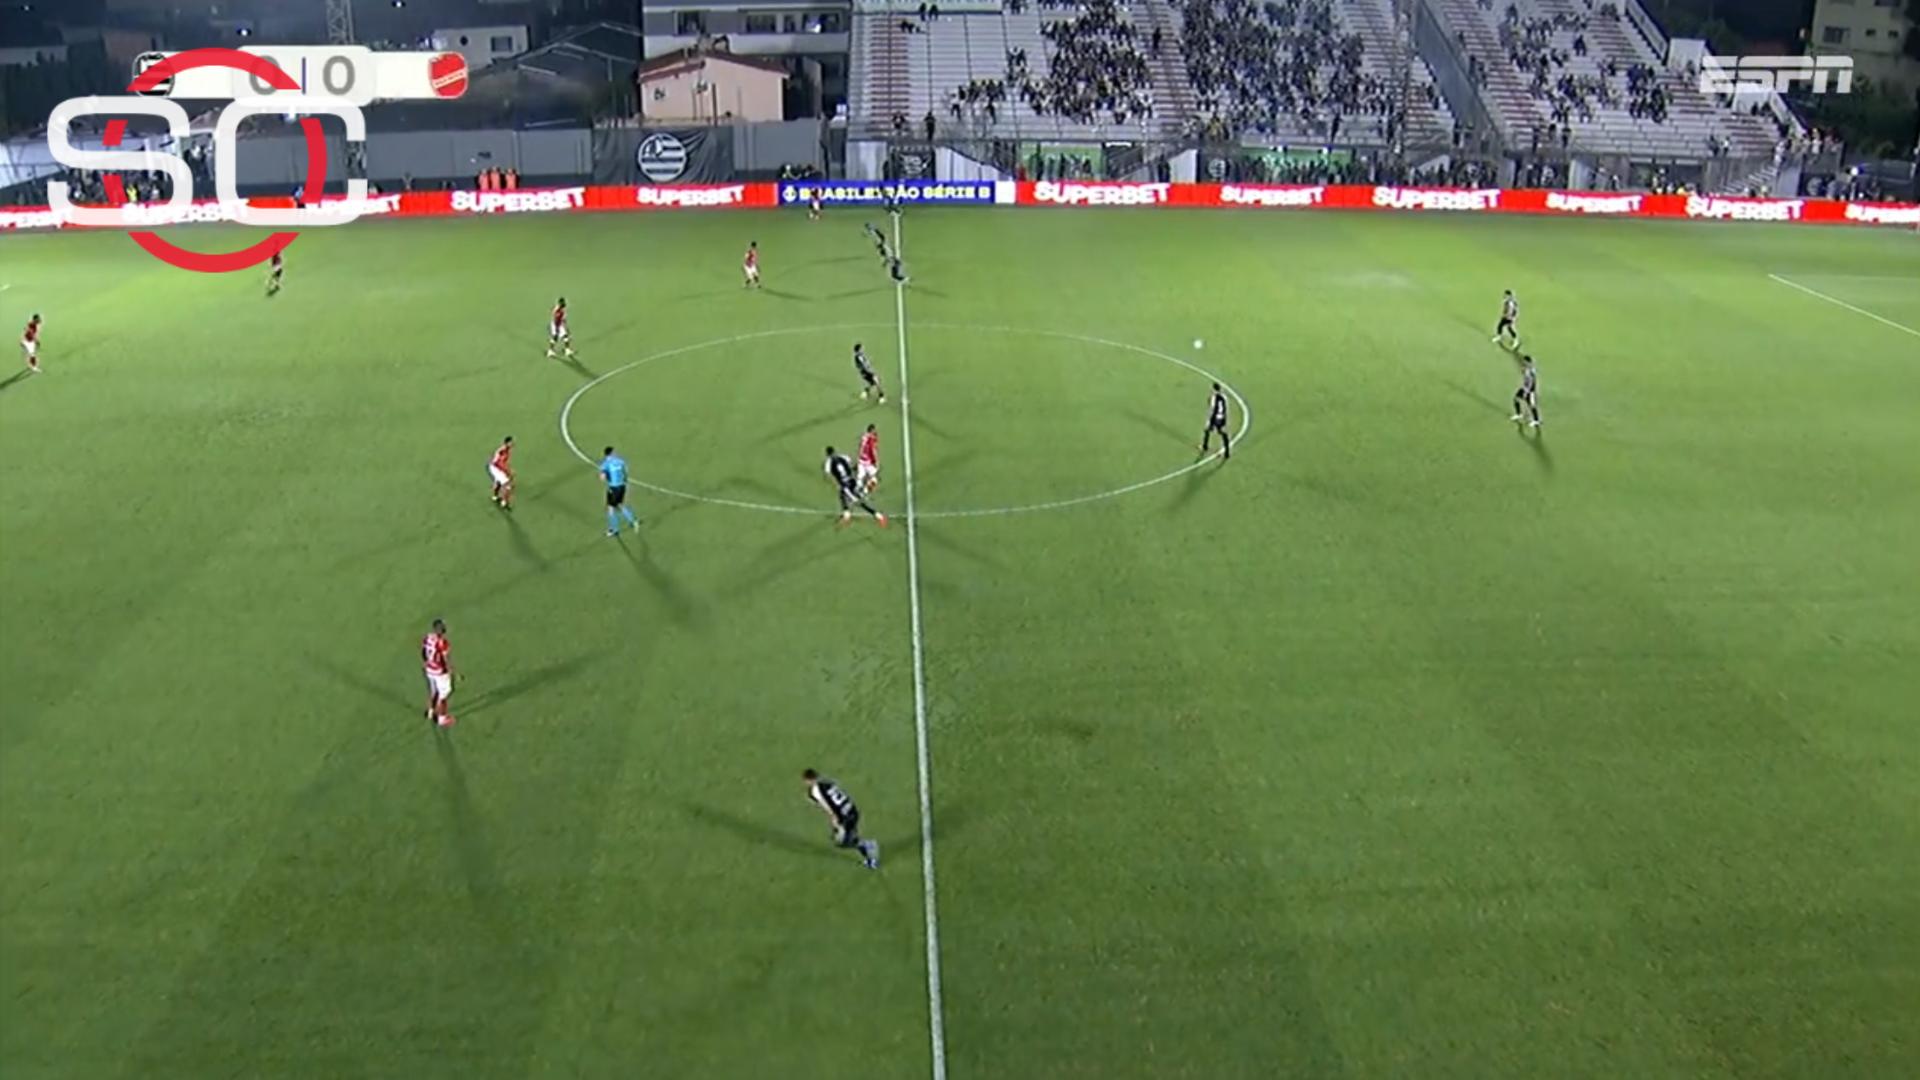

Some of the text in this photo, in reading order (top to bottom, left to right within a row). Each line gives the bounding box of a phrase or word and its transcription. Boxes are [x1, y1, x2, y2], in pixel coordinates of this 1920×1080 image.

[451, 187, 584, 212] SUPERBET
[636, 185, 744, 206] SUPERBET
[923, 184, 975, 199] SÉRIE
[979, 187, 991, 199] B
[1034, 181, 1169, 205] SUPERBET
[1221, 185, 1324, 206] SUPERBET
[1372, 186, 1500, 210] SUPERBET
[1546, 192, 1642, 213] SUPERBET
[1685, 196, 1804, 221] SUPERBET
